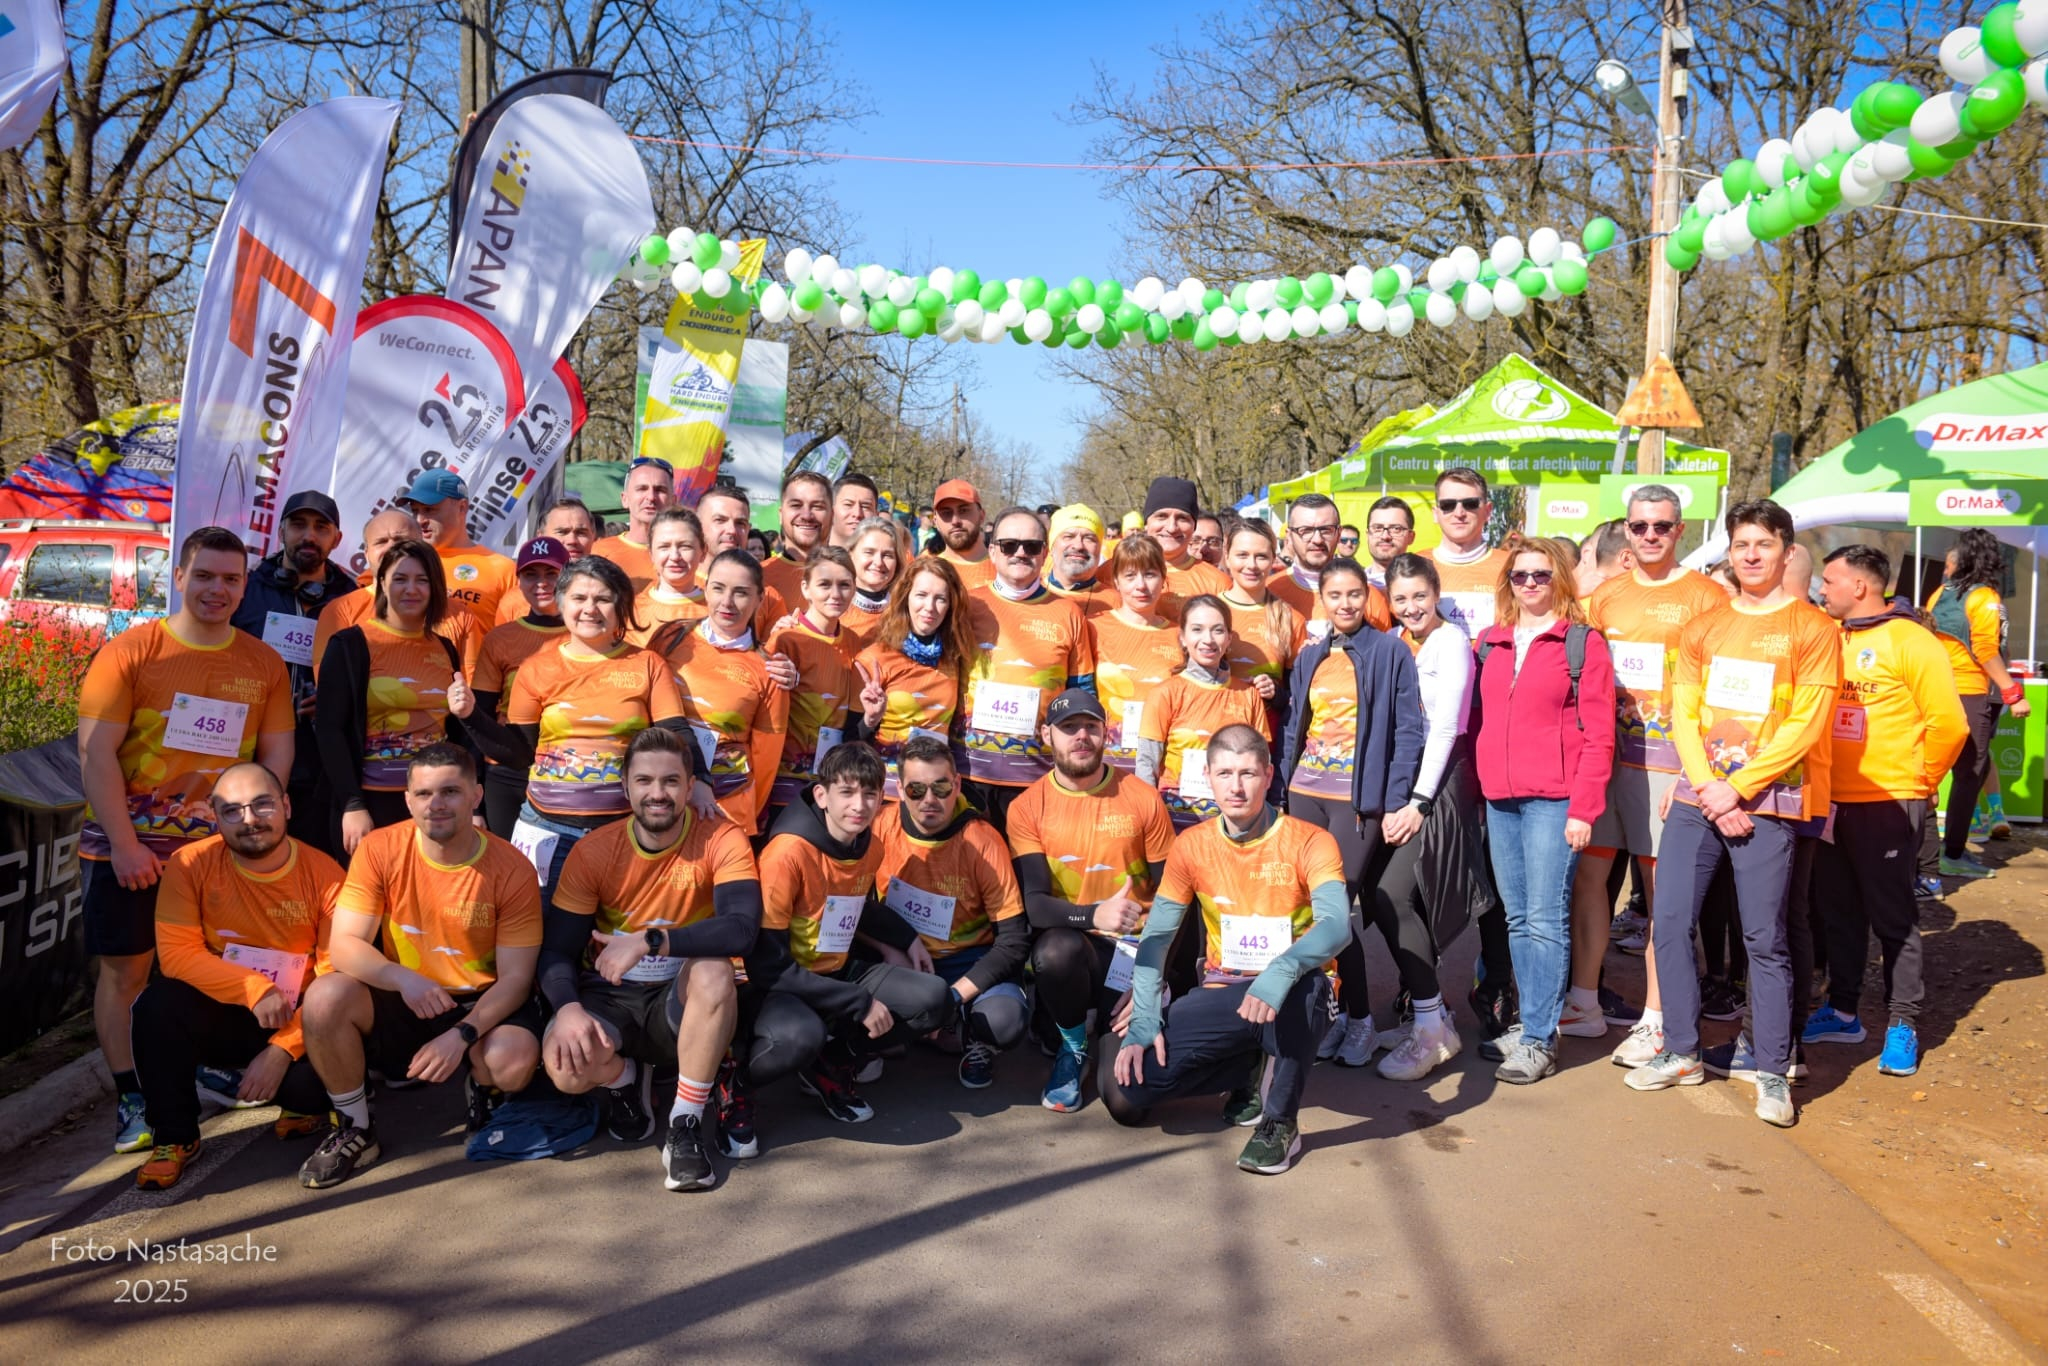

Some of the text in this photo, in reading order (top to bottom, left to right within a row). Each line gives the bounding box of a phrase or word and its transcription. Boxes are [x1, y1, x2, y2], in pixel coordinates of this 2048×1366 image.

[463, 186, 521, 310] APAN
[689, 309, 734, 323] ENDURO
[379, 333, 476, 360] WeConnect.
[670, 388, 729, 403] HARD ENDURO
[465, 405, 505, 451] Romania
[1934, 423, 2048, 442] Dr.Max
[247, 332, 300, 557] LEMACONS
[541, 419, 570, 458] Romania
[1390, 456, 1429, 471] Centru
[1434, 455, 1480, 470] medical
[1485, 455, 1528, 470] dedicat
[1947, 497, 2004, 509] Dr.Max
[1449, 608, 1475, 619] 444
[1020, 624, 1056, 635] RUNNING
[1032, 619, 1057, 629] MEGA
[284, 631, 313, 647] 435
[1035, 631, 1057, 642] TEAM
[1622, 658, 1644, 671] 453
[1722, 675, 1750, 692] 225
[991, 700, 1019, 714] 445
[194, 716, 226, 734] 458
[1104, 815, 1131, 823] MEGA
[1109, 830, 1135, 838] TEAM
[904, 900, 932, 918] 423
[1239, 935, 1269, 950] 443
